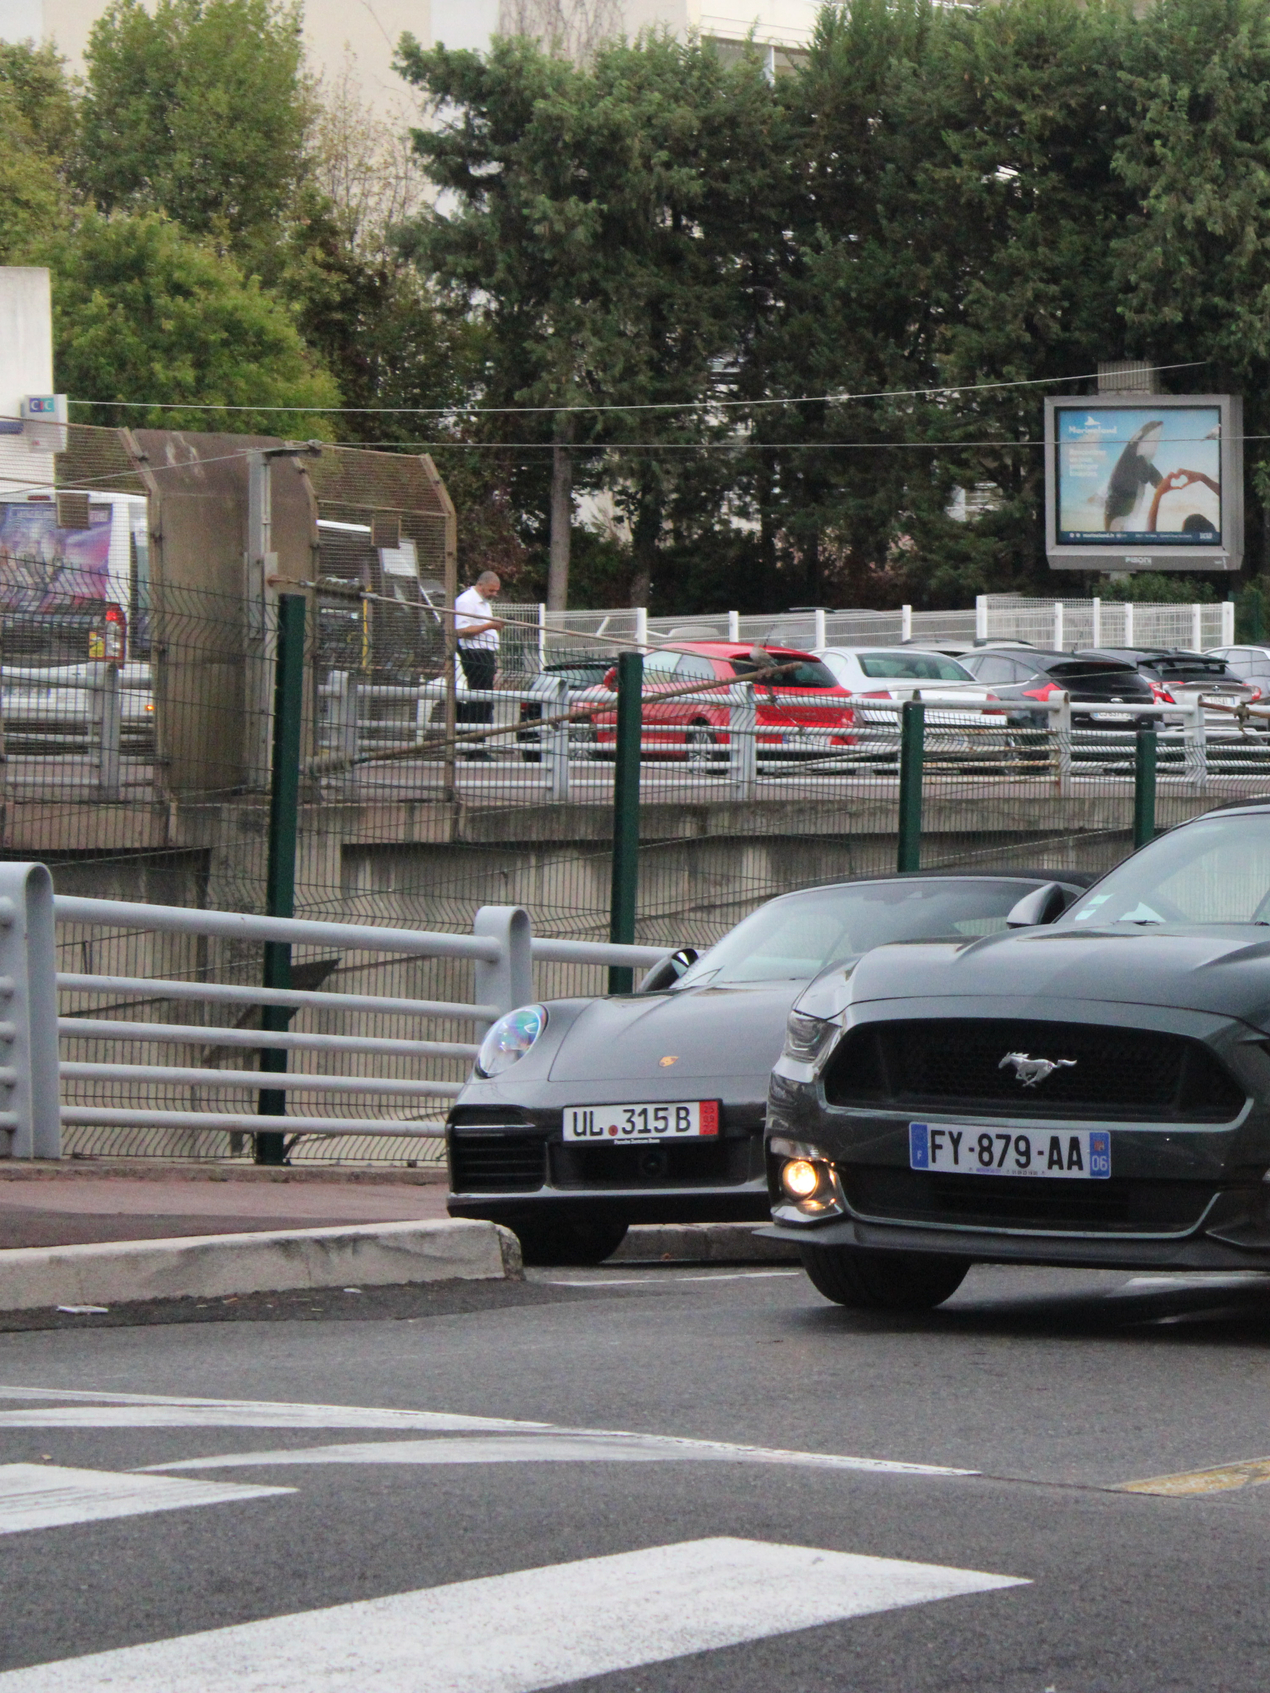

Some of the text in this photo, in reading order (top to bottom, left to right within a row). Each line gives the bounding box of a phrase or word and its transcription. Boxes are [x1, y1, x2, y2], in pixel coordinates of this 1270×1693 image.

[30, 400, 53, 411] CIC
[572, 1110, 604, 1137] UL
[917, 1151, 922, 1160] F
[930, 1129, 1084, 1171] FY-879-AA
[1091, 1154, 1108, 1171] 06
